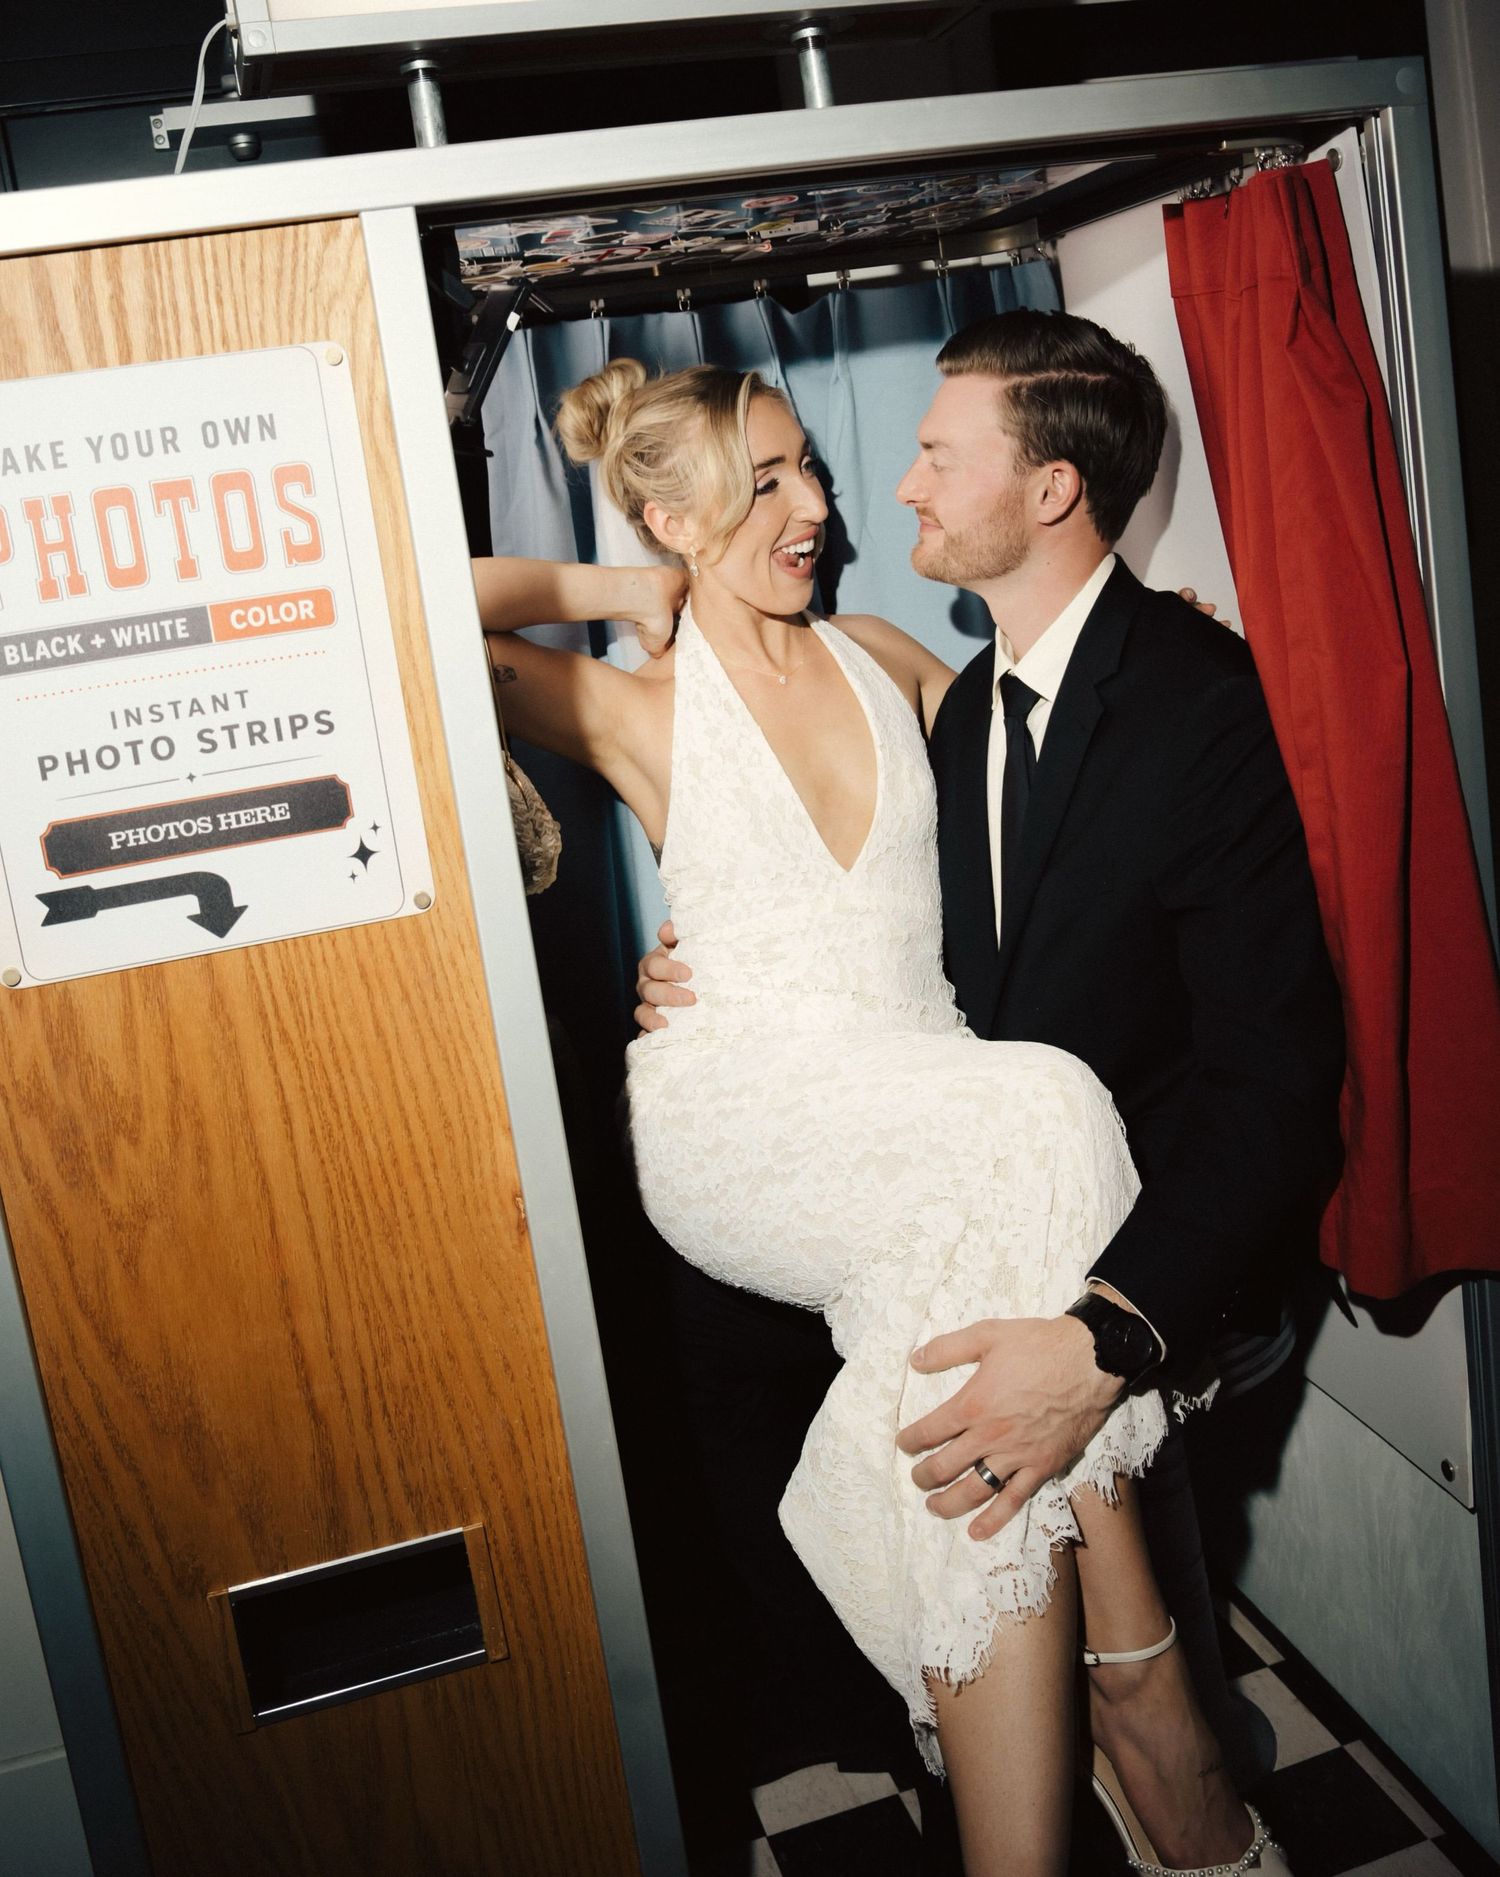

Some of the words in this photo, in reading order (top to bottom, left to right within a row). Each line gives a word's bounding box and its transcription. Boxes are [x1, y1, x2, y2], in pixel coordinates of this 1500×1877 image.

[85, 426, 181, 464] YOUR
[201, 413, 278, 449] OWN
[229, 600, 316, 630] COLOR
[4, 635, 85, 666] BLACK
[90, 634, 106, 648] +
[110, 617, 189, 647] WHITE
[110, 690, 250, 730] INSTANT
[37, 735, 176, 781] PHOTO
[197, 709, 336, 754] STRIPS
[108, 816, 214, 850] PHOTOS
[218, 803, 291, 832] HERE
